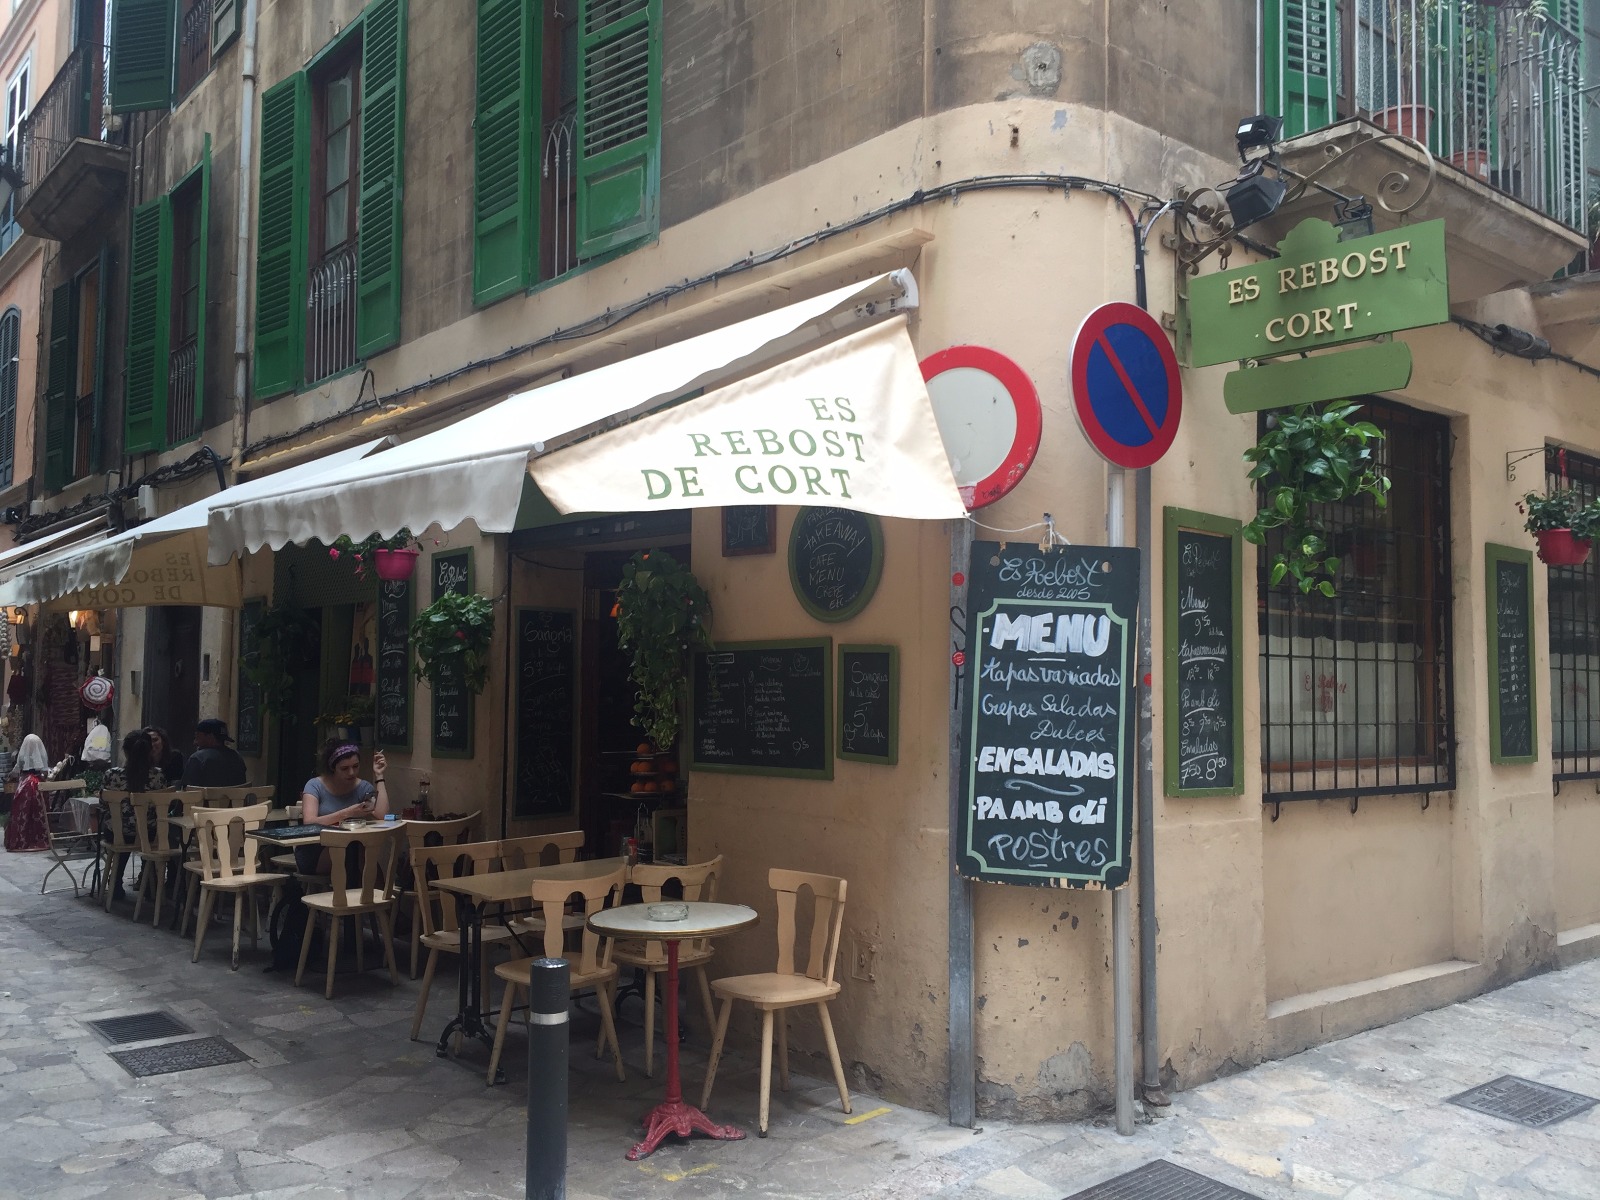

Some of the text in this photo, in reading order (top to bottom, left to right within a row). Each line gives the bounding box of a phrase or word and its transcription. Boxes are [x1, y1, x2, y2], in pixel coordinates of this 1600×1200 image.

[1228, 241, 1411, 305] ES REBOST
[1265, 302, 1358, 343] CORT
[805, 397, 856, 423] ES
[686, 428, 866, 462] REBOST
[640, 465, 852, 500] DE CORT
[809, 567, 845, 586] MENU
[999, 558, 1022, 582] Es
[1016, 586, 1090, 600] desde 2005
[990, 612, 1112, 657] MENU
[981, 657, 1120, 692] tapas variadas
[1040, 694, 1117, 718] Saladas
[1030, 719, 1106, 743] Dulces
[978, 746, 1116, 780] ENSALADAS
[976, 796, 1008, 821] PA
[1010, 800, 1064, 824] AMB
